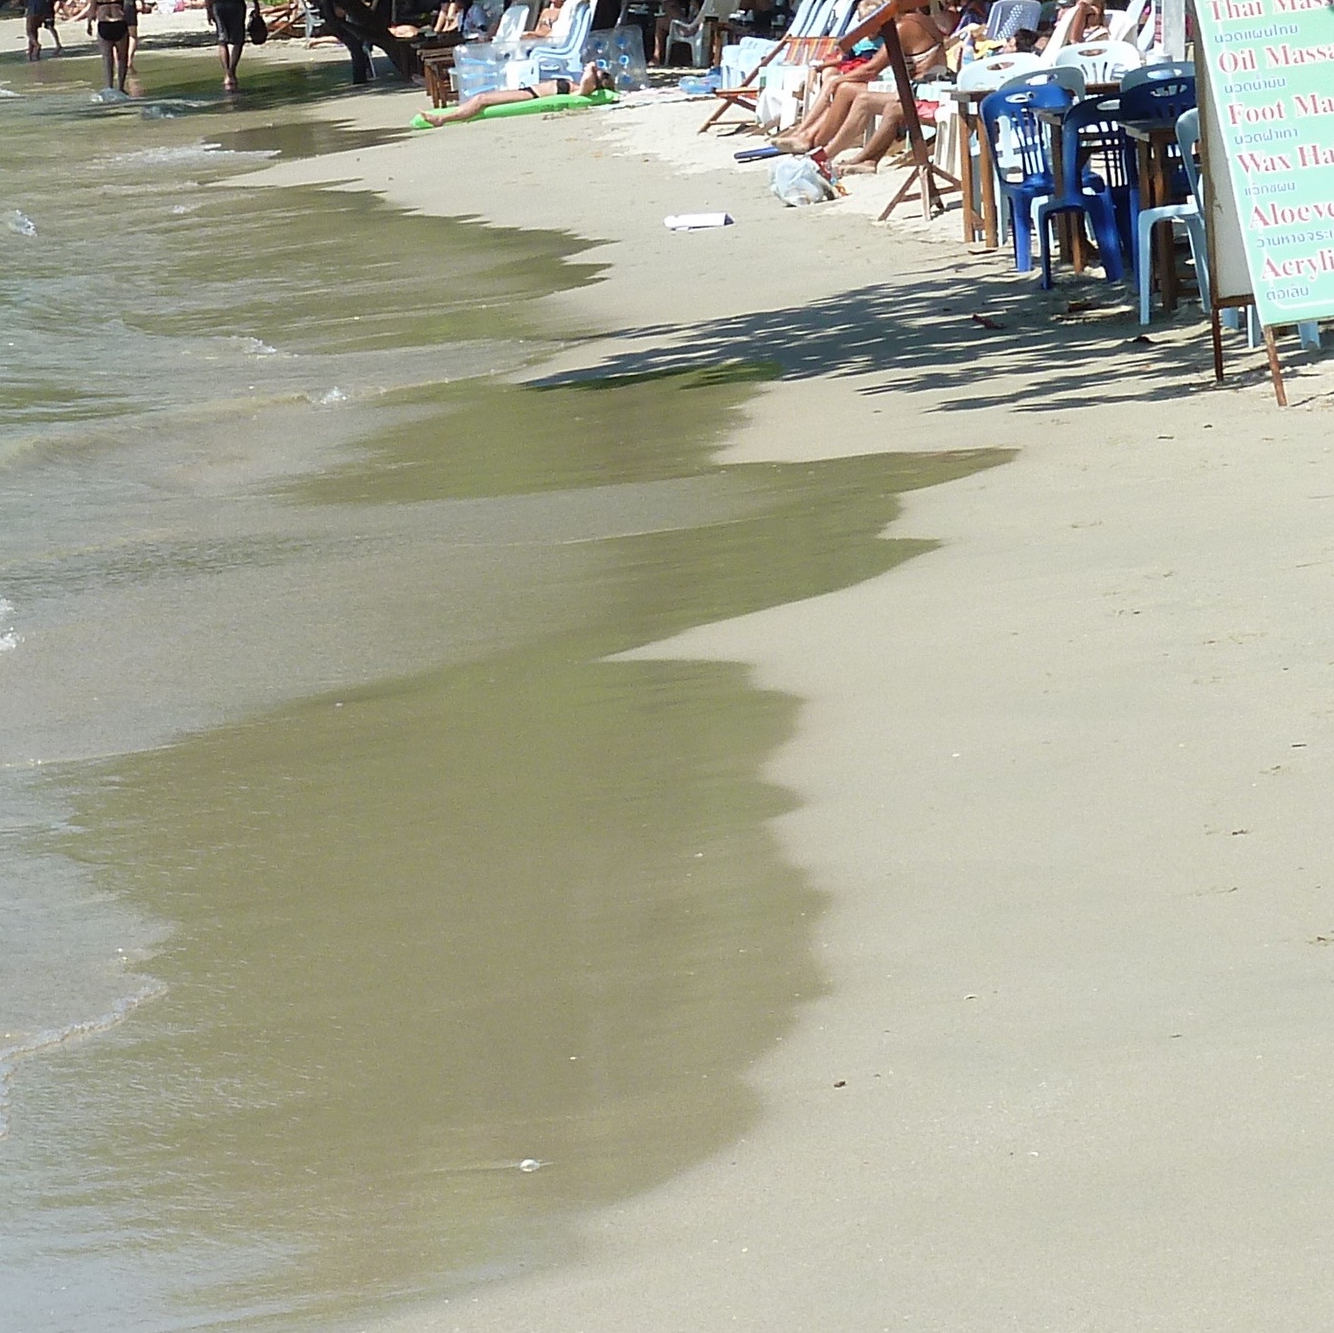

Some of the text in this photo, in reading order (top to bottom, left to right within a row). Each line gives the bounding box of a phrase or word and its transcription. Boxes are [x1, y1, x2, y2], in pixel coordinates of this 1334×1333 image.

[1218, 48, 1257, 74] Oil
[1228, 101, 1285, 126] Foot
[1237, 151, 1292, 175] Wax
